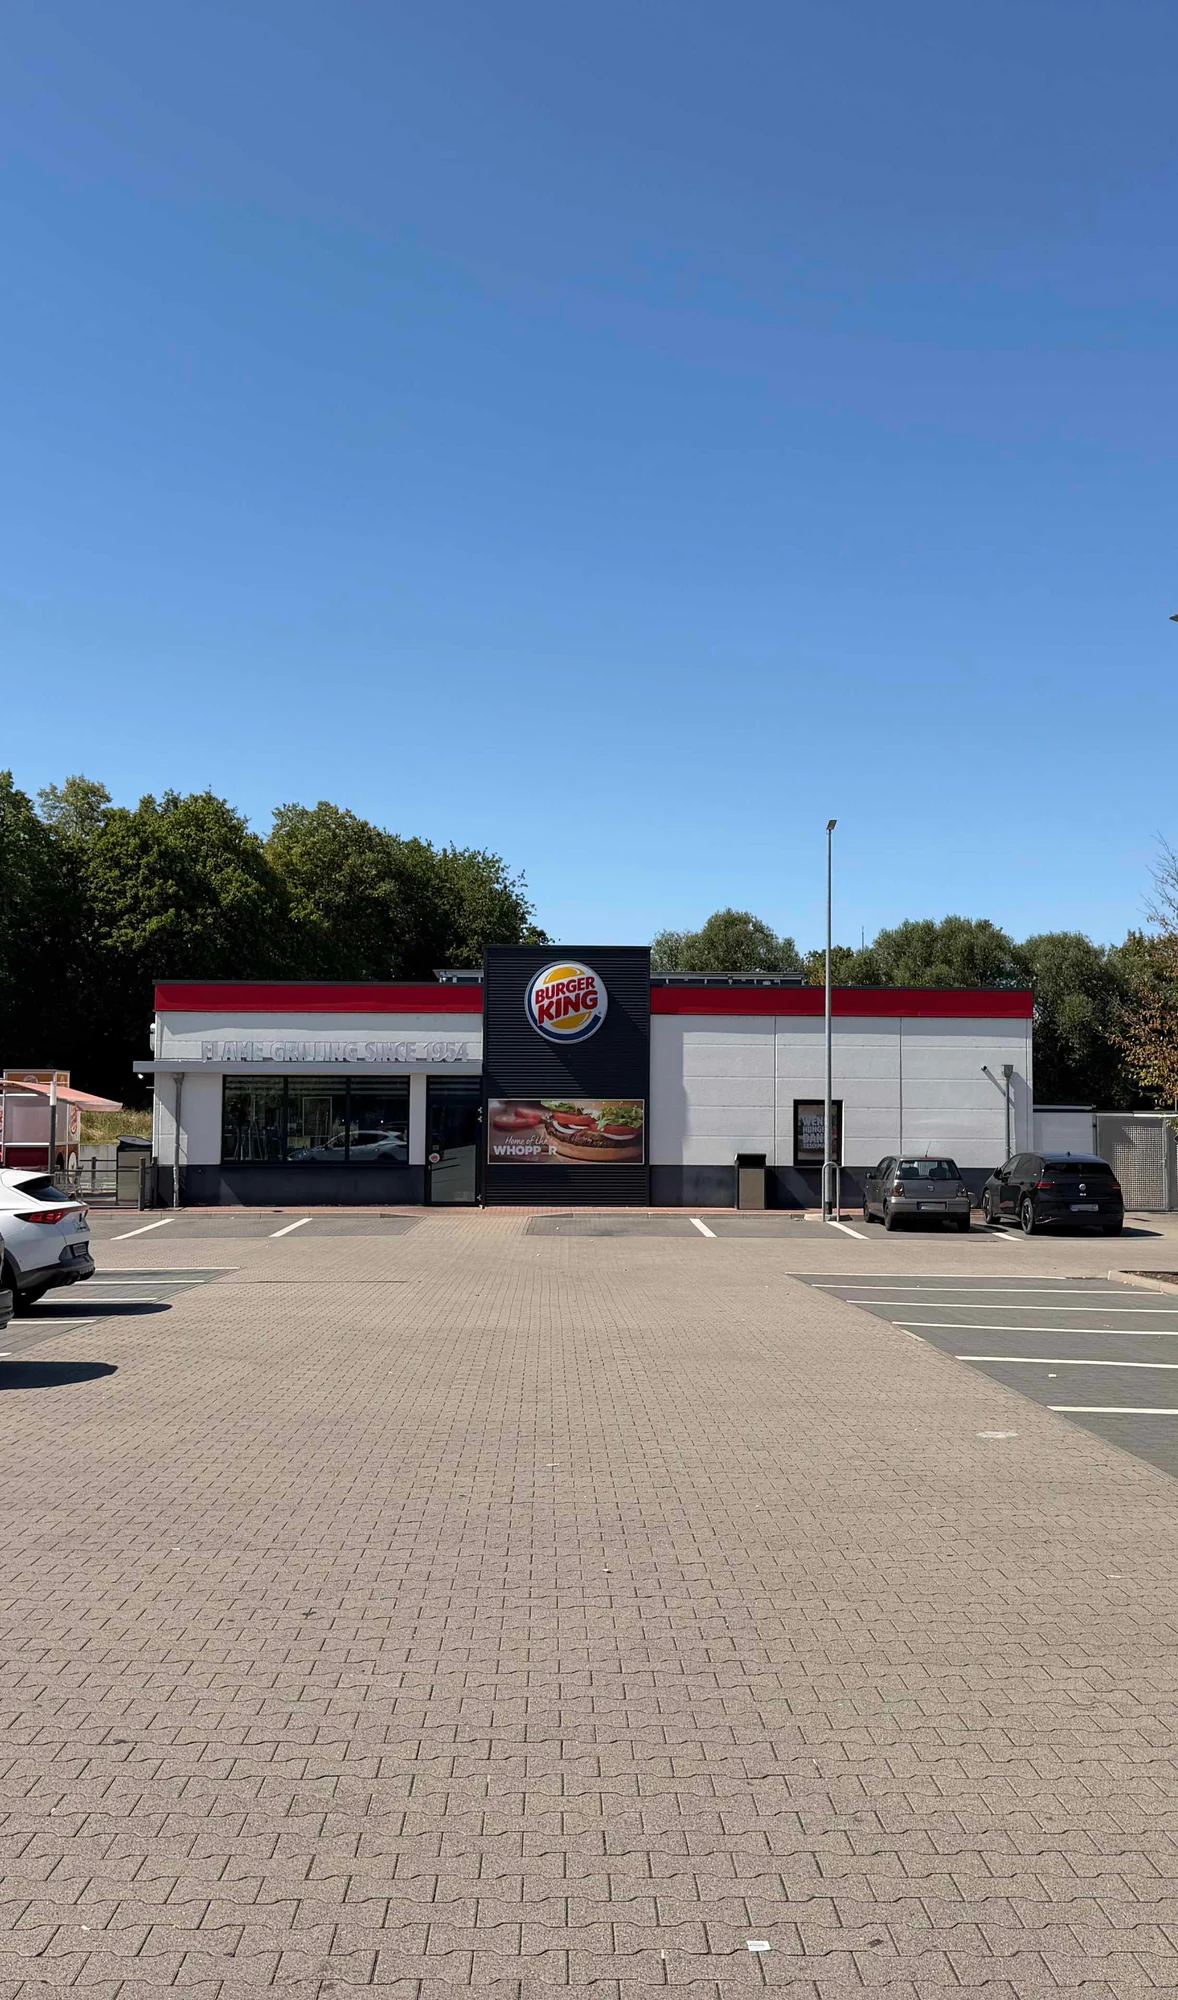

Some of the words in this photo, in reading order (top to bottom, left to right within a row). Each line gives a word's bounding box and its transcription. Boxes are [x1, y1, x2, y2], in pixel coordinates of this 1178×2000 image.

[535, 976, 596, 1006] BURGER
[537, 990, 598, 1026] KING
[202, 1041, 264, 1062] FLAME
[270, 1041, 358, 1062] GRILLING
[365, 1041, 417, 1062] SINCE
[423, 1041, 468, 1062] 1954
[802, 1116, 827, 1126] WEN
[802, 1126, 827, 1134] HUNGE
[505, 1136, 525, 1145] Home
[526, 1135, 536, 1146] of
[535, 1135, 549, 1145] the
[802, 1133, 827, 1143] DAN
[493, 1145, 557, 1155] WHOPPR
